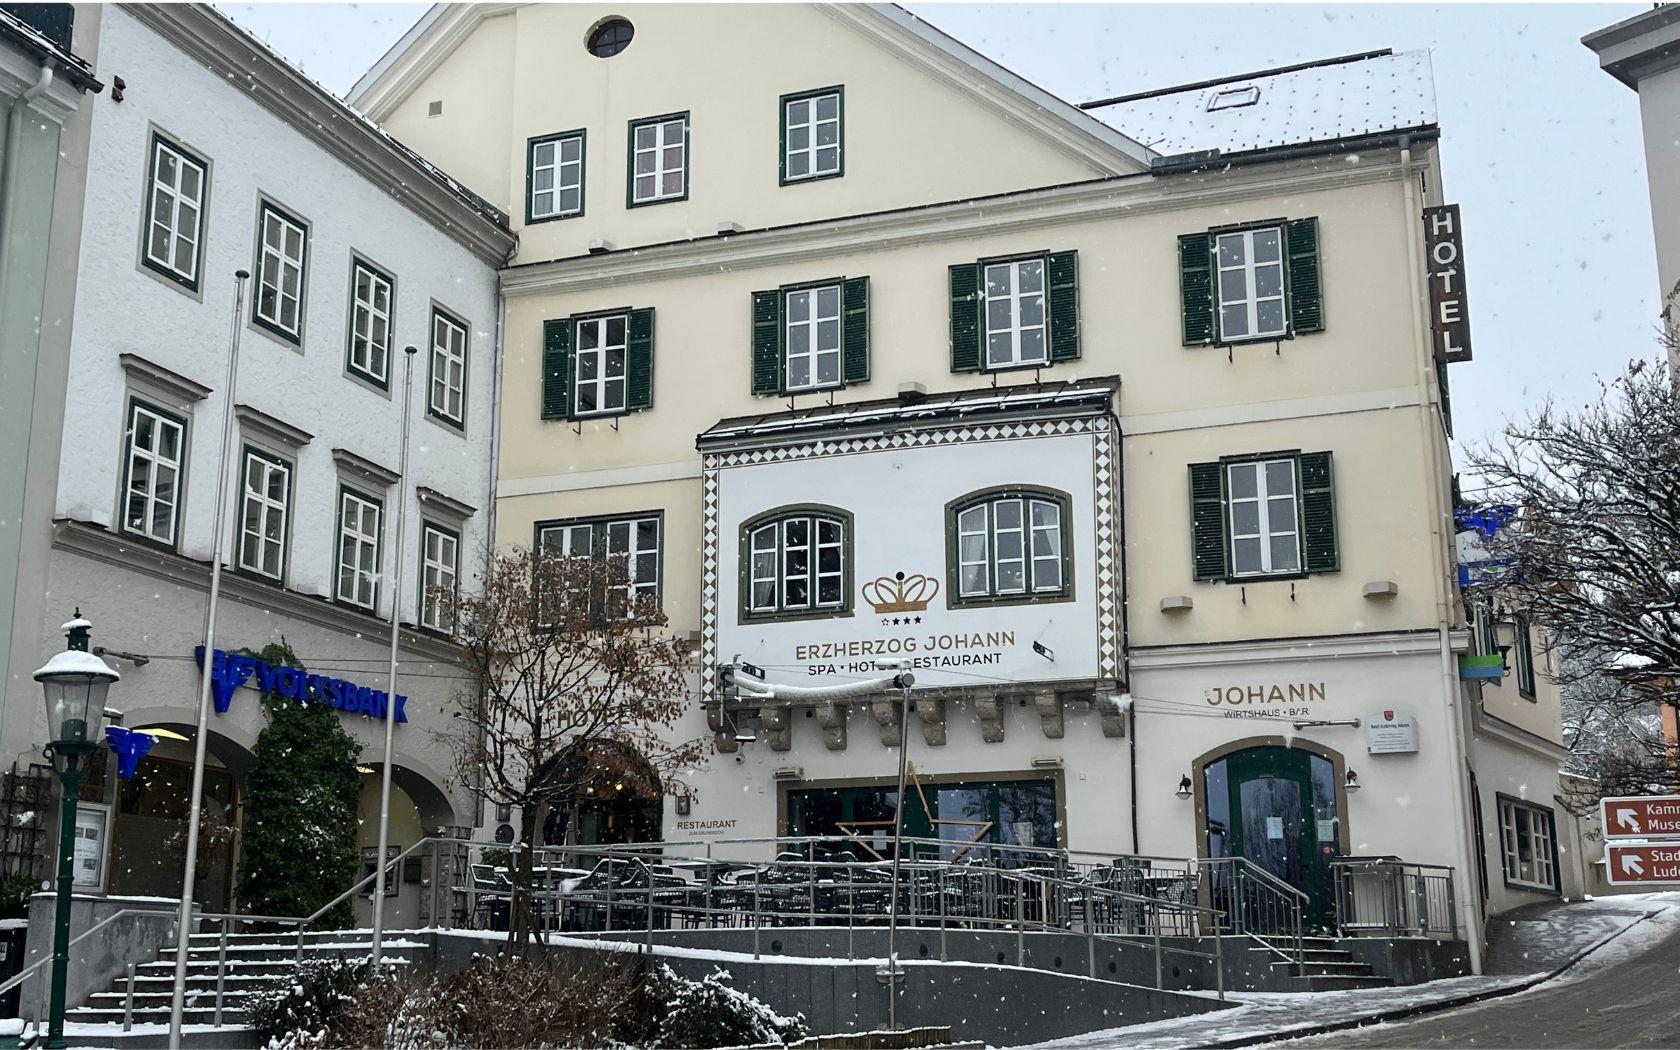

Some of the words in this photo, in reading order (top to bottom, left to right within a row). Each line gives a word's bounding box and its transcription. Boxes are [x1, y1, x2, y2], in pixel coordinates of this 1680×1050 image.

[1431, 212, 1463, 353] HOTEL
[795, 637, 917, 661] ERZHERZOG
[923, 631, 1015, 651] JOHANN
[808, 664, 836, 676] SPA
[911, 653, 1002, 669] ESTAURANT
[256, 660, 409, 724] VOLKSBANK
[1206, 682, 1326, 706] JOHANN
[1224, 708, 1280, 719] WIRTSHAUS
[677, 819, 737, 830] RESTAURANT
[1653, 865, 1680, 878] Lud
